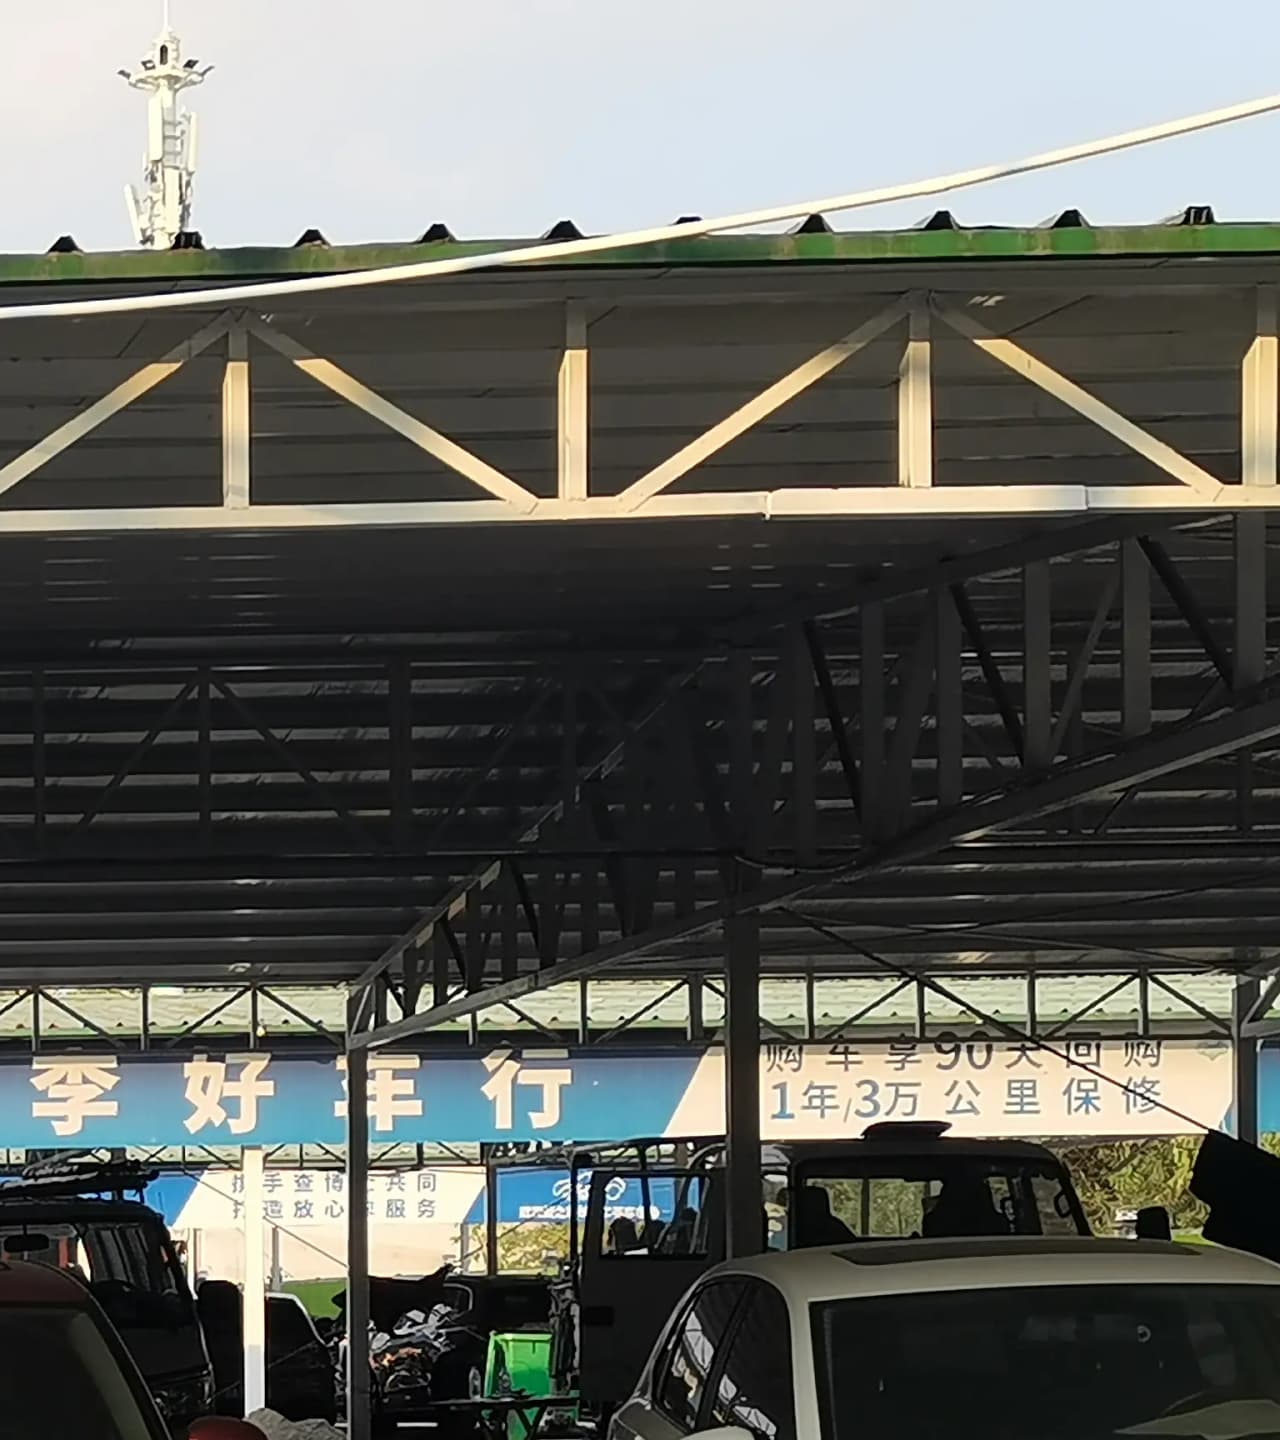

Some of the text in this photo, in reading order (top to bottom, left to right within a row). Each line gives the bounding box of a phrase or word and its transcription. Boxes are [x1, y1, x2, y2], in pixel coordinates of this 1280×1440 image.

[30, 1047, 572, 1136] 李好车行
[769, 1077, 1161, 1123] 1年/3万公里保修
